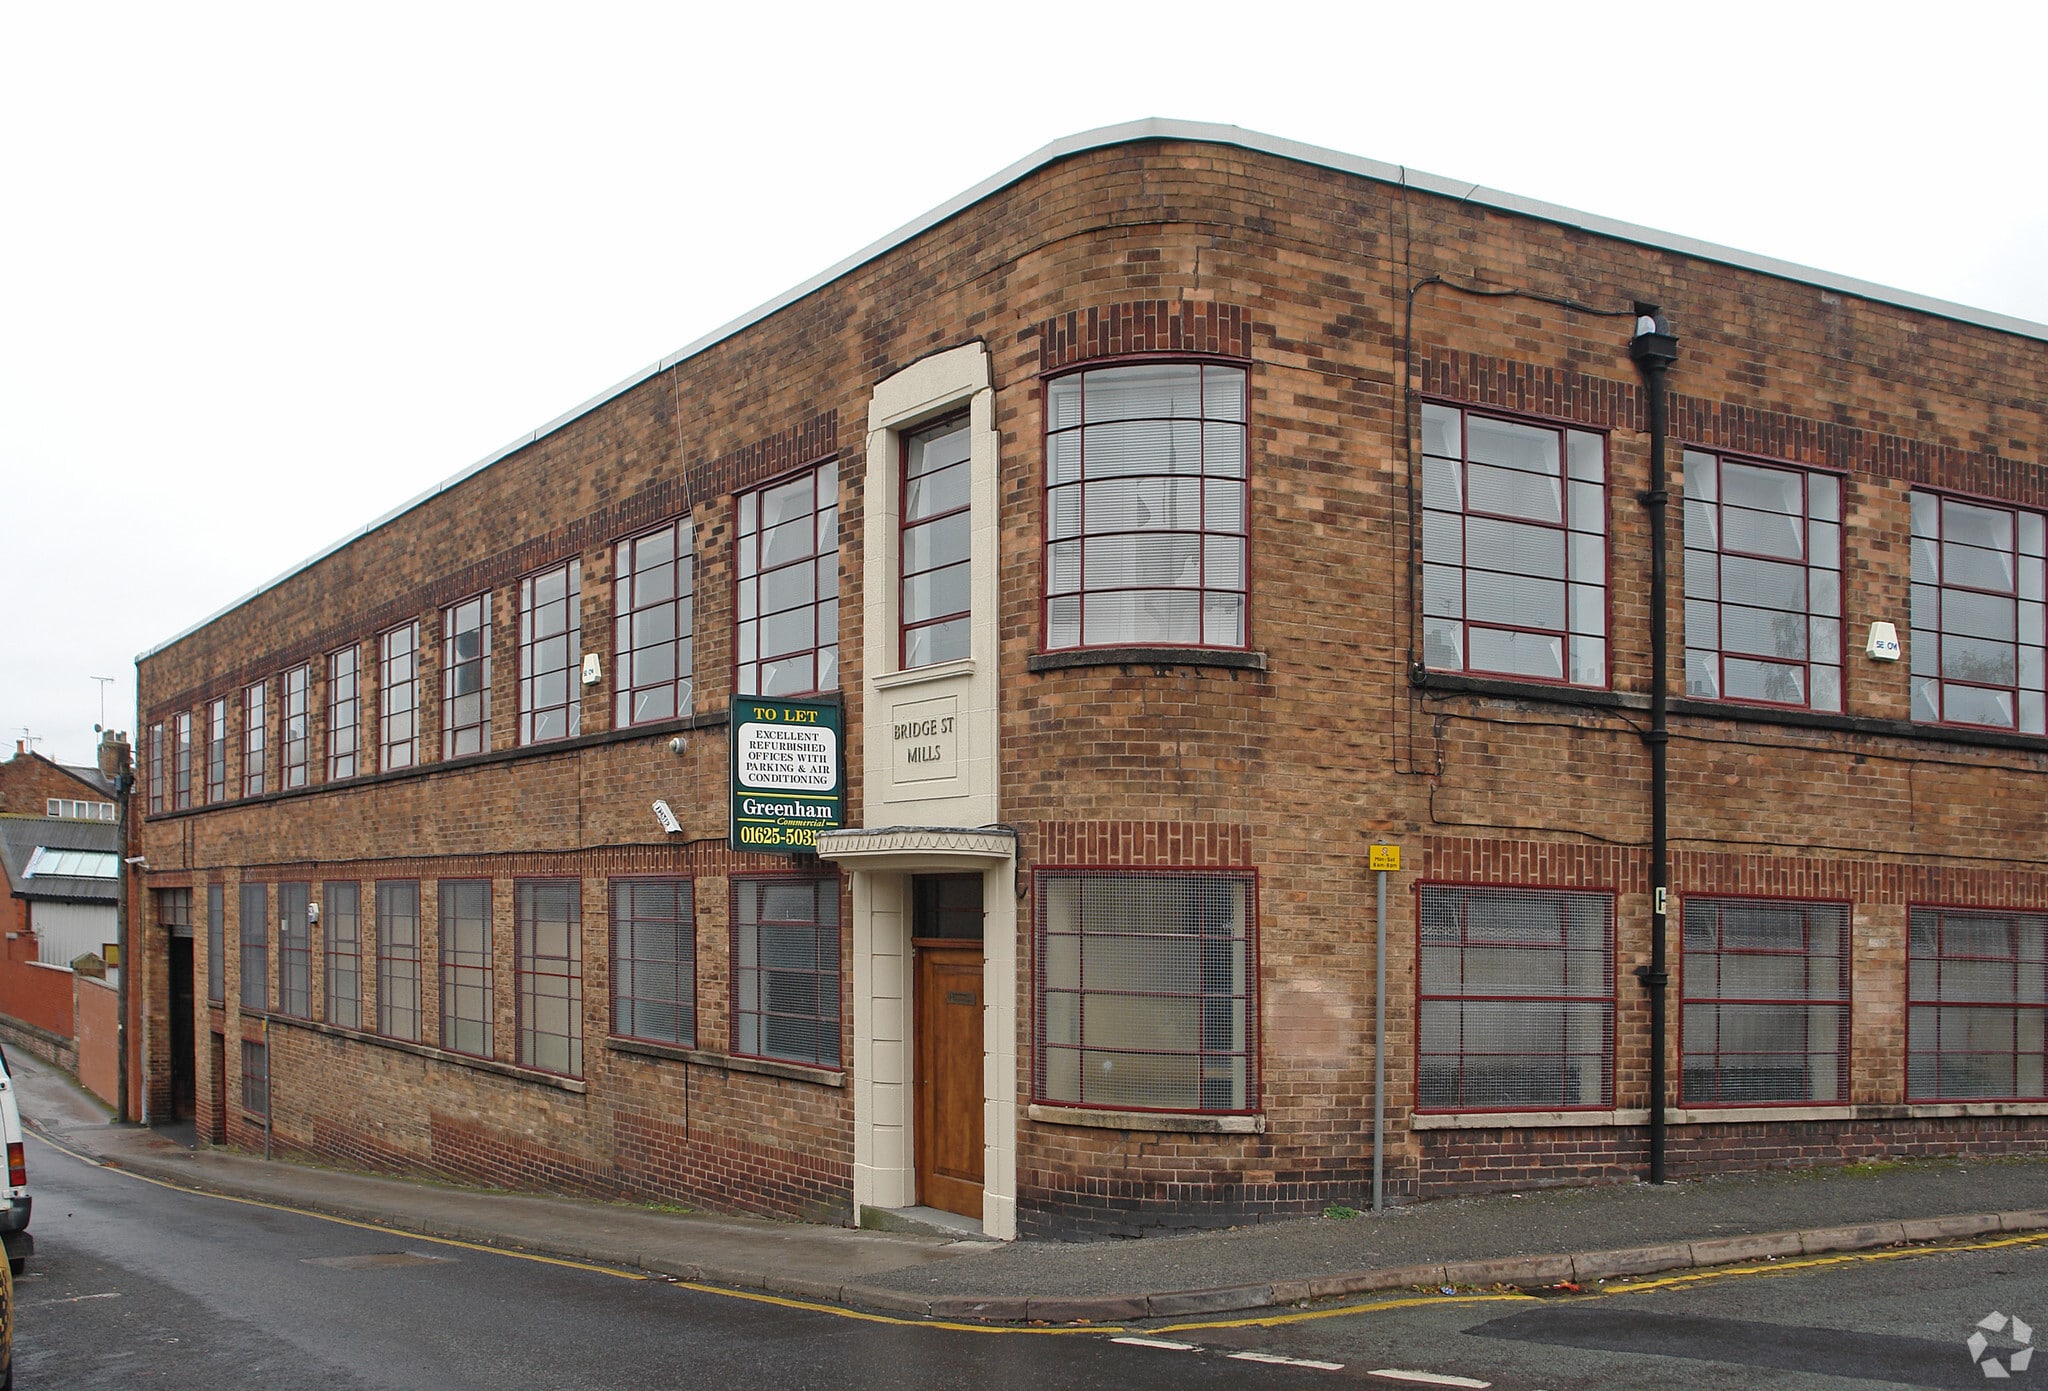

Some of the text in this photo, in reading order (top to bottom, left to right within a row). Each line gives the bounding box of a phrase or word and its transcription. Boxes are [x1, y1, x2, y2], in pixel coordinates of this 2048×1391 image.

[753, 707, 818, 723] TO LET
[894, 717, 954, 740] BRIDGE ST
[756, 730, 820, 742] EXCELLENT
[749, 741, 826, 753] REFURBISHED
[748, 752, 827, 764] OFFICES WITH
[907, 745, 941, 763] MILLS
[746, 762, 830, 775] PARKING & AIR
[748, 773, 828, 785] CONDITIONING
[742, 798, 833, 819] Greenham
[776, 817, 826, 828] Commercial
[740, 826, 825, 847] 01625-5031
